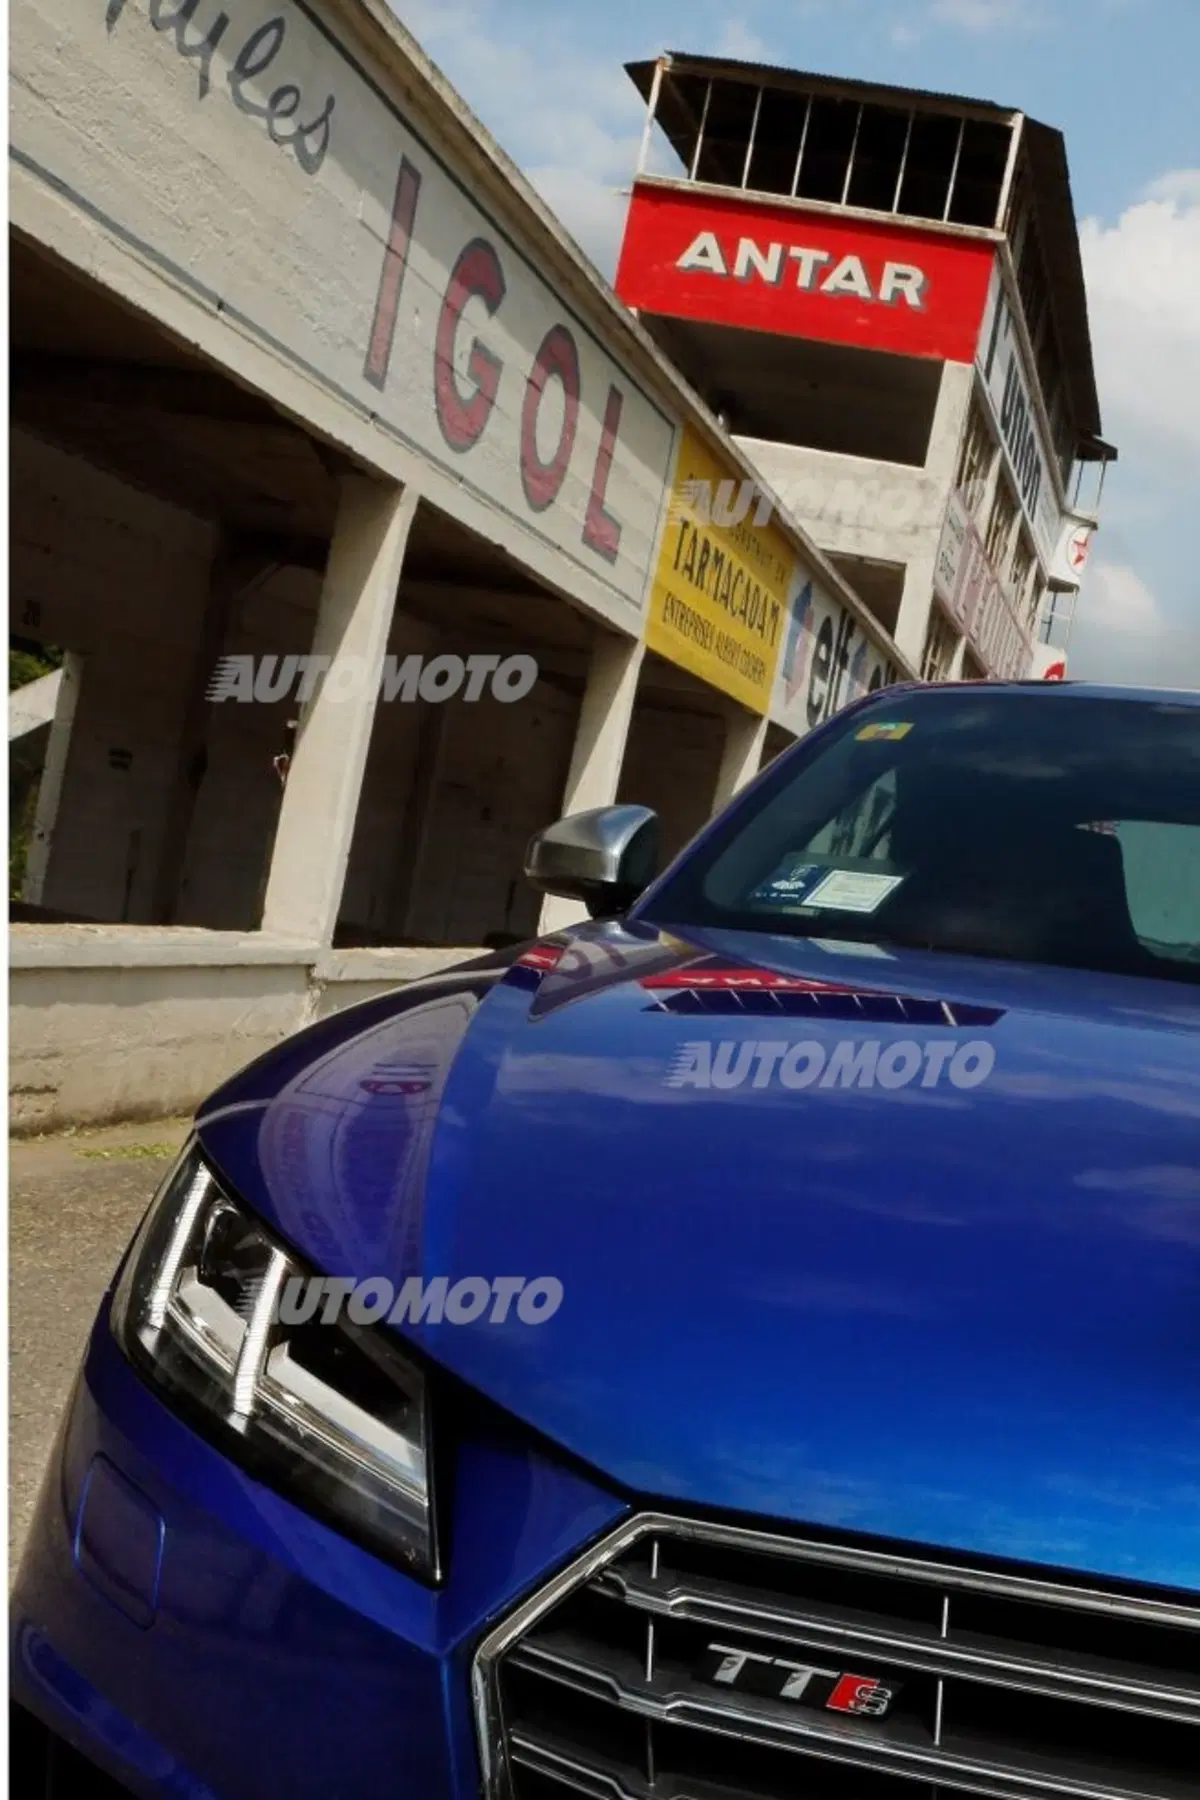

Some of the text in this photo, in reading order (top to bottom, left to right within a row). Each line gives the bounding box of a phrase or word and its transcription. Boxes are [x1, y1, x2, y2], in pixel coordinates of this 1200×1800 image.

[675, 231, 931, 312] ANTAR
[363, 153, 622, 565] IGOL
[673, 517, 780, 648] TARMACADAM
[806, 604, 857, 730] elf
[708, 1643, 892, 1716] TTS
